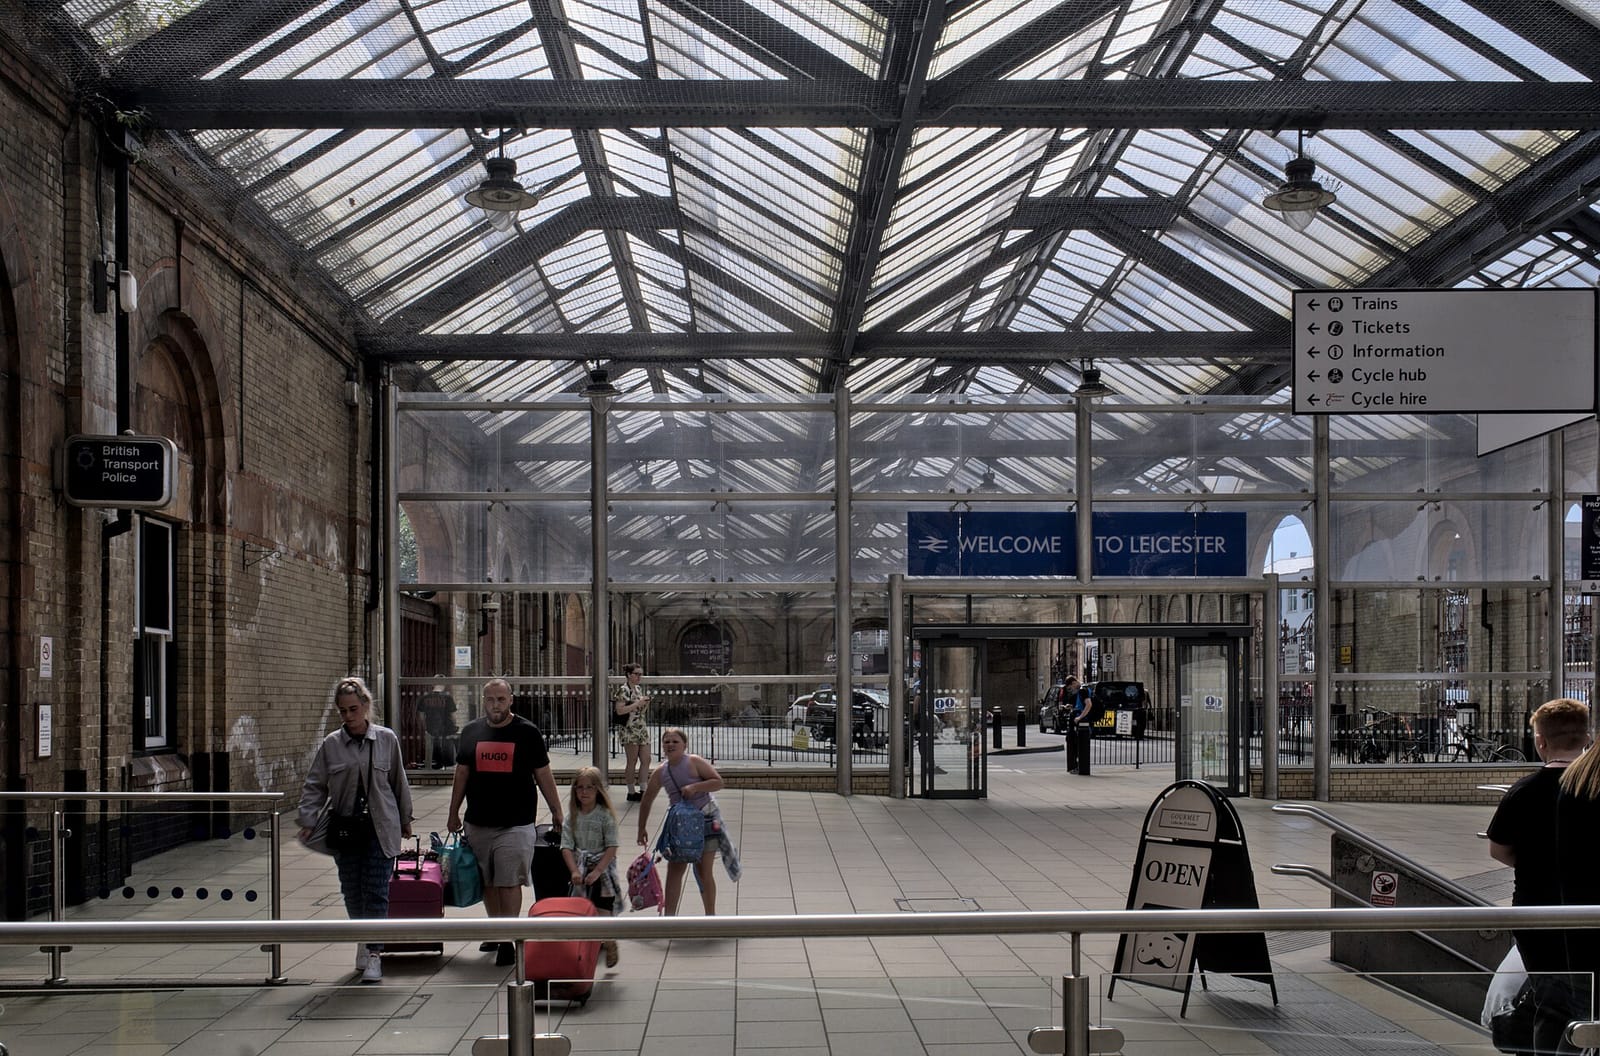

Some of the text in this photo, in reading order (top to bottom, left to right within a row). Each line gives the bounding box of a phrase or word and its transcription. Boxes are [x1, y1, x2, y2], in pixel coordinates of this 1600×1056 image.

[1352, 296, 1398, 310] Trains
[1352, 320, 1411, 334] Tickets
[1353, 344, 1445, 358] Information
[1351, 367, 1427, 385] Cycle hub
[1351, 391, 1394, 408] Cycle
[1400, 392, 1427, 405] hire
[102, 445, 140, 456] British
[103, 458, 159, 471] Transport
[102, 471, 137, 482] Police
[957, 535, 1227, 554] WELCOME TO LEICESTER
[480, 752, 508, 761] HUGO
[1145, 860, 1205, 887] OPEN
